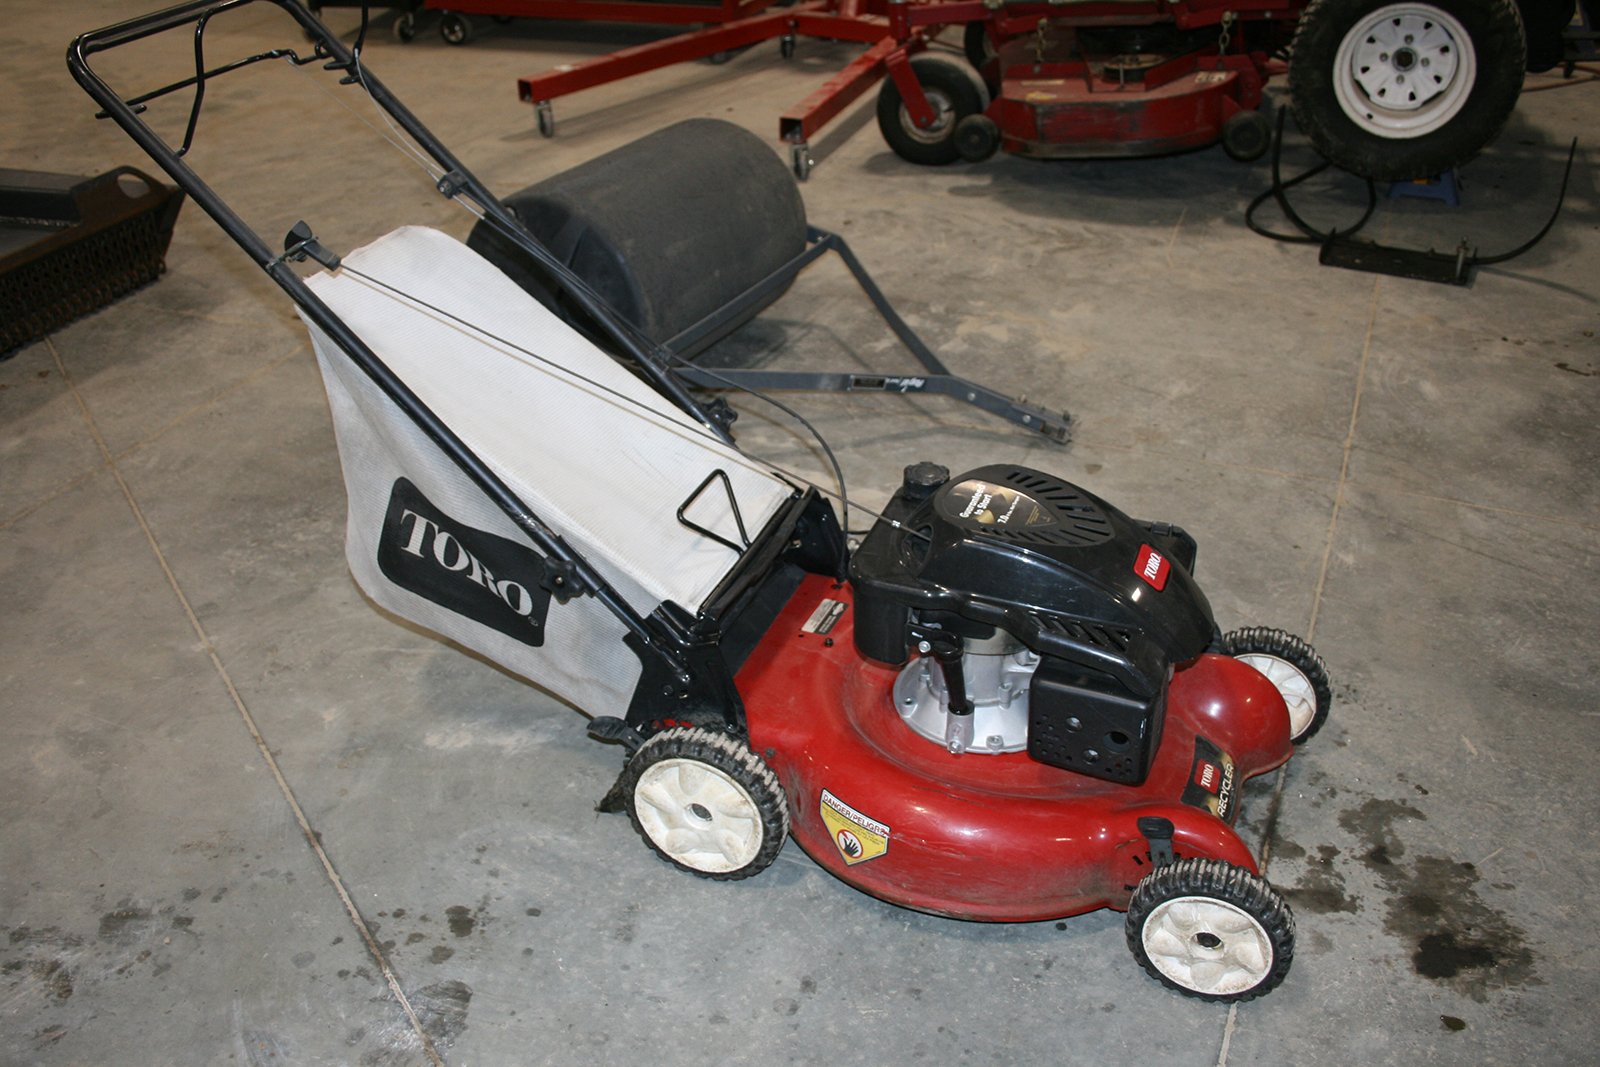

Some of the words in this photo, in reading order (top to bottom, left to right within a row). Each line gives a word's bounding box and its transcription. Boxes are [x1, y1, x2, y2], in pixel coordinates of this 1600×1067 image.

[959, 483, 985, 518] Guaranteed
[977, 494, 992, 510] Start
[401, 509, 533, 616] TORO
[1144, 552, 1161, 580] TORO
[1201, 764, 1214, 788] TORO
[1217, 763, 1234, 817] RECYCLER
